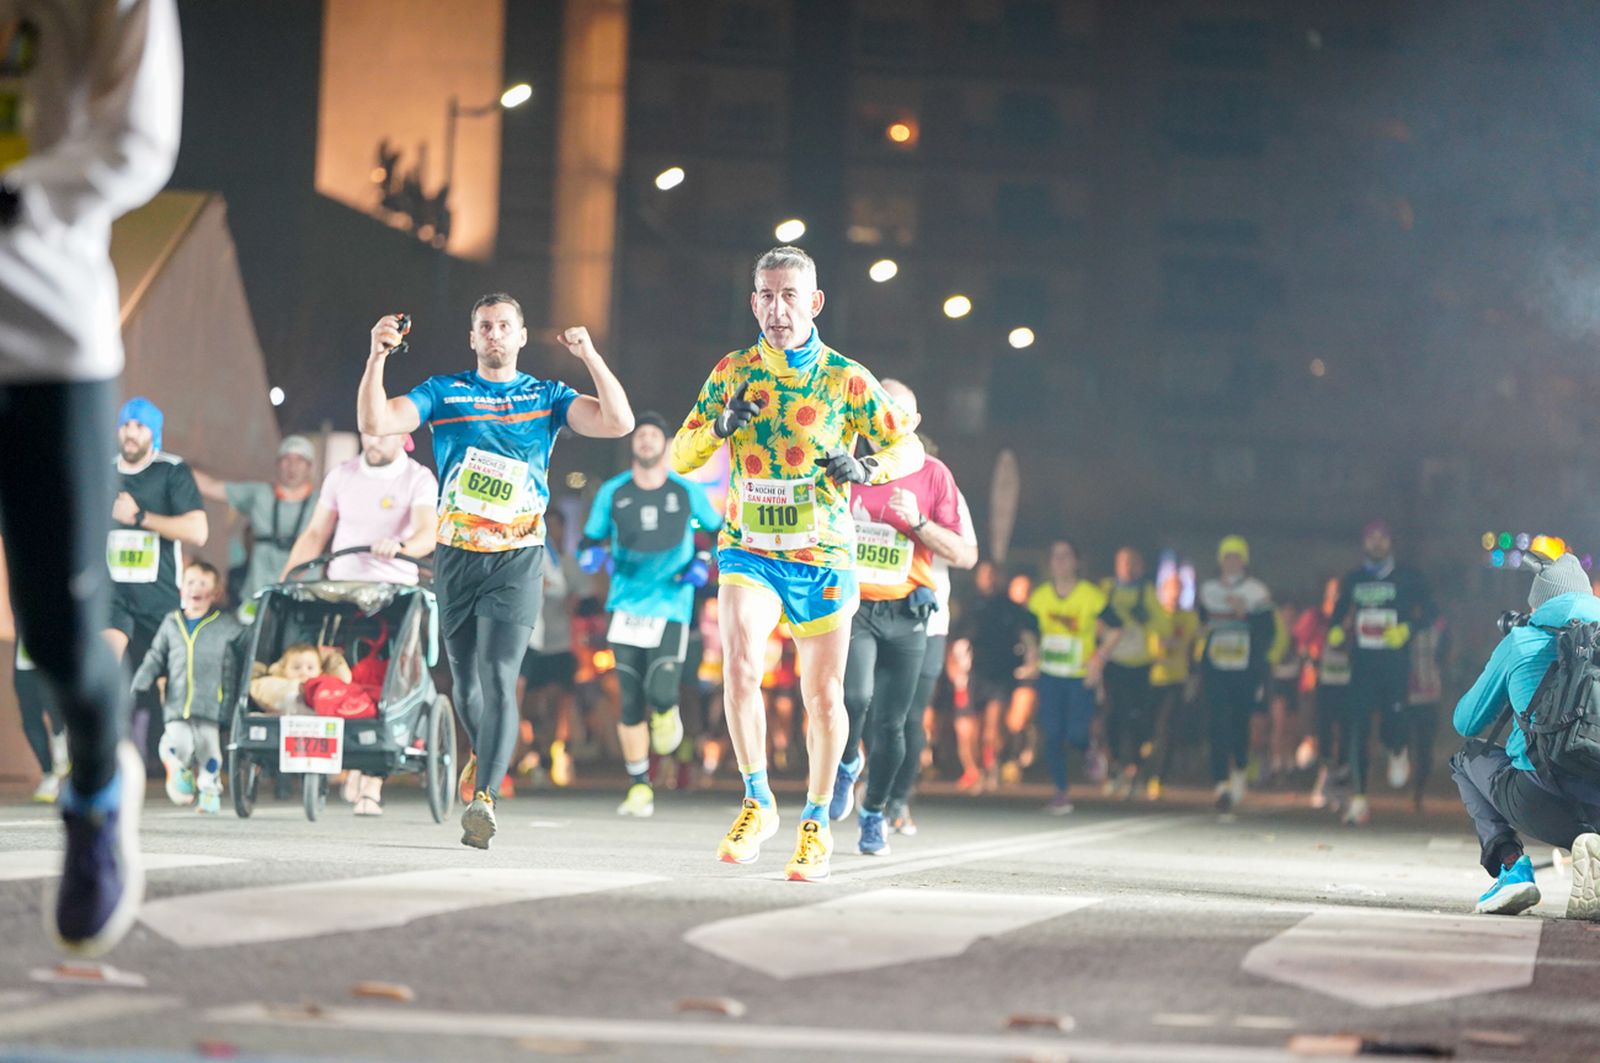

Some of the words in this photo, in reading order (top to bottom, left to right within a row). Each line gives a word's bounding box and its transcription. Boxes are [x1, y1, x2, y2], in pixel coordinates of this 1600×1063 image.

[468, 472, 513, 501] 6209
[755, 486, 776, 495] NOCHE
[777, 488, 786, 496] DE
[747, 494, 762, 503] SAN
[757, 505, 798, 527] 1110
[857, 544, 900, 565] 9596
